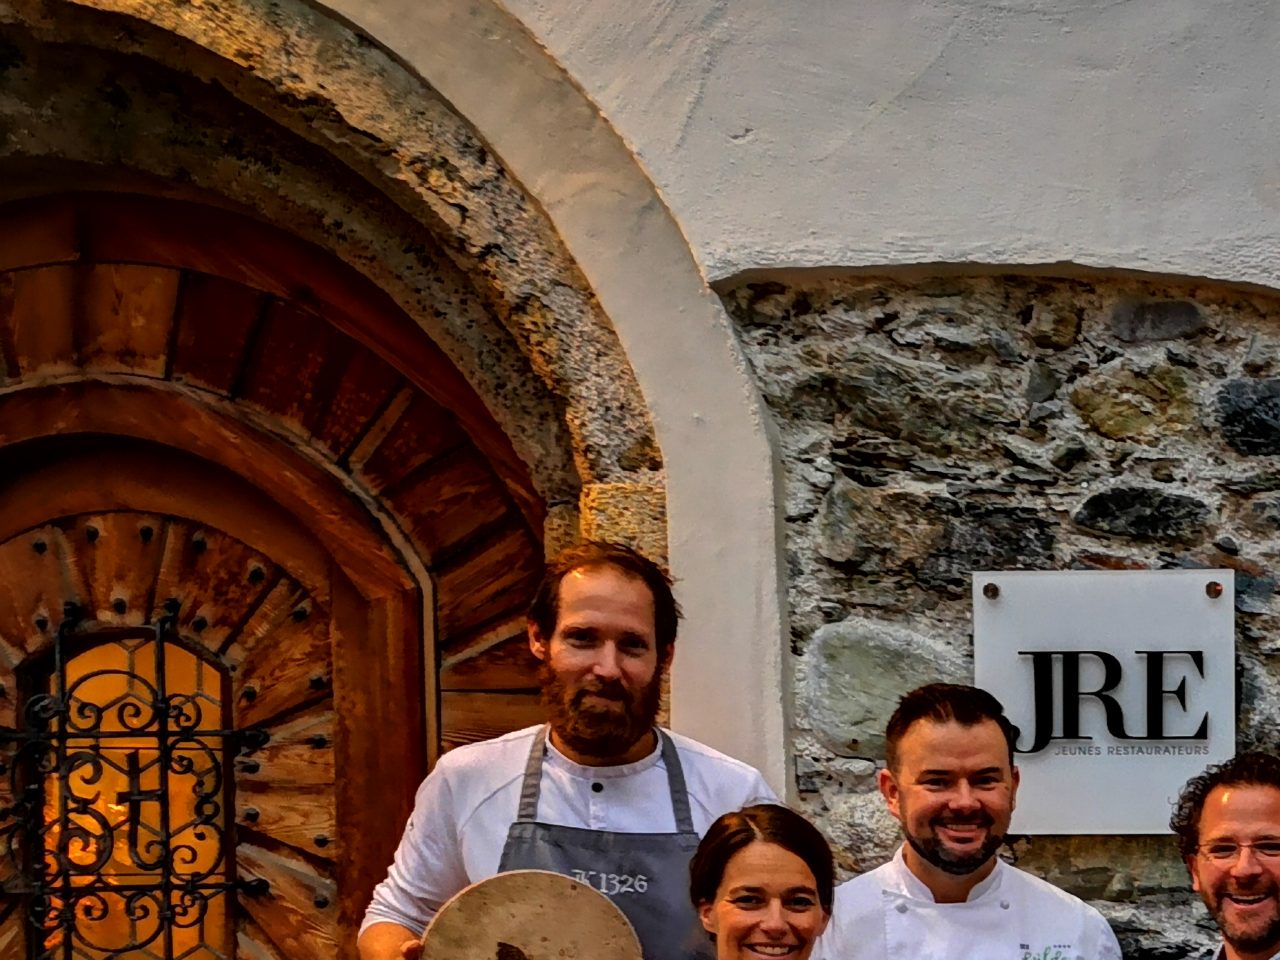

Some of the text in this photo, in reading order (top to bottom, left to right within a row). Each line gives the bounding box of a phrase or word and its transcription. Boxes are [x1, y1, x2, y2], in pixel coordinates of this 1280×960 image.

[1012, 650, 1208, 754] JRE
[1054, 745, 1210, 757] JEUNES RESTAURATEURS
